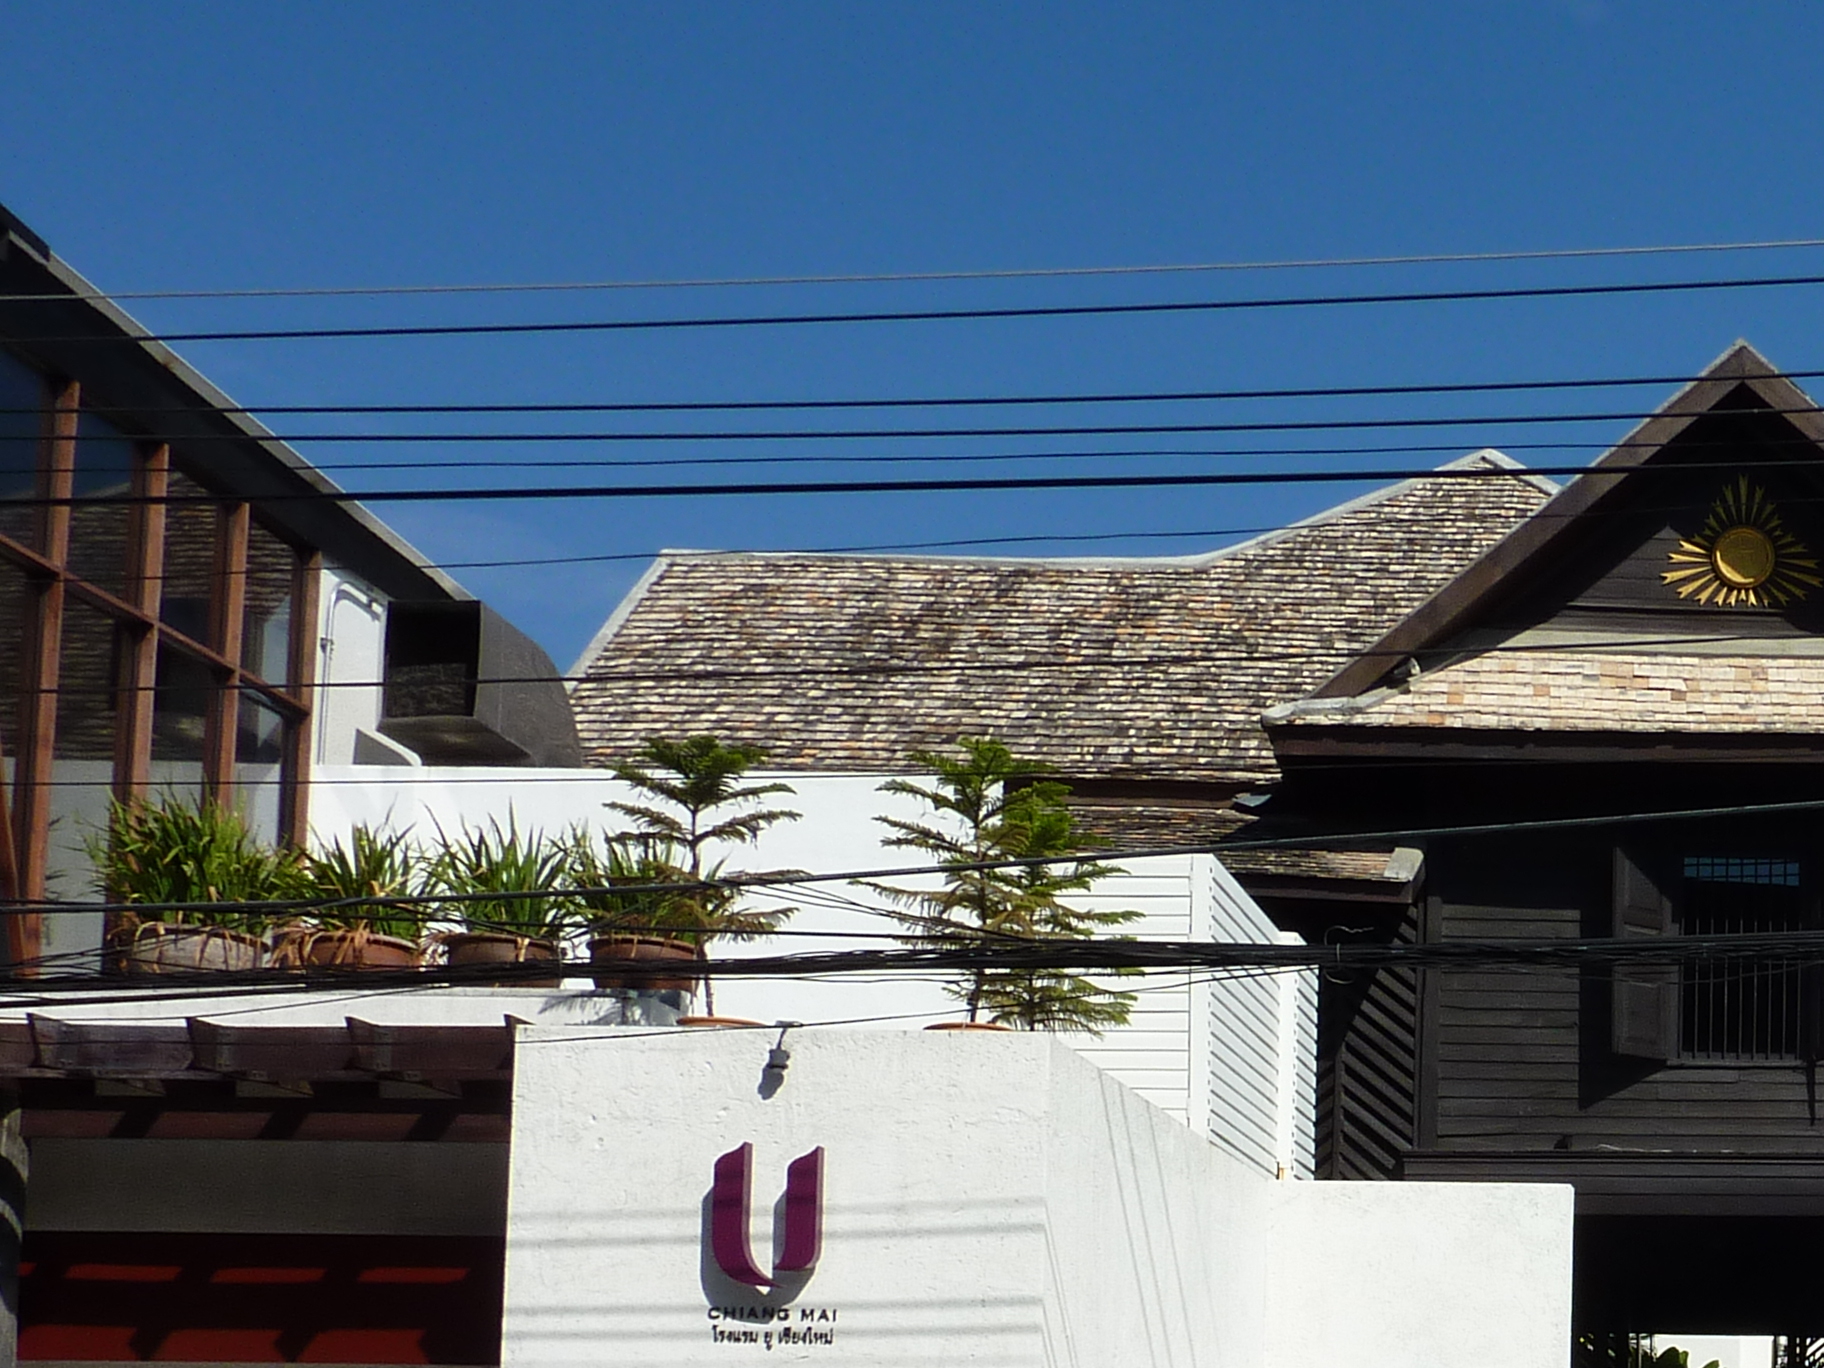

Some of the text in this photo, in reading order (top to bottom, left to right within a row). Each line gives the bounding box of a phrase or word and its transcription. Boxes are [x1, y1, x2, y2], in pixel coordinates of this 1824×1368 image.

[707, 1306, 837, 1322] CHIANG MAI
[712, 1324, 758, 1343] โรงแรม
[778, 1326, 833, 1344] เชียงใหม่
